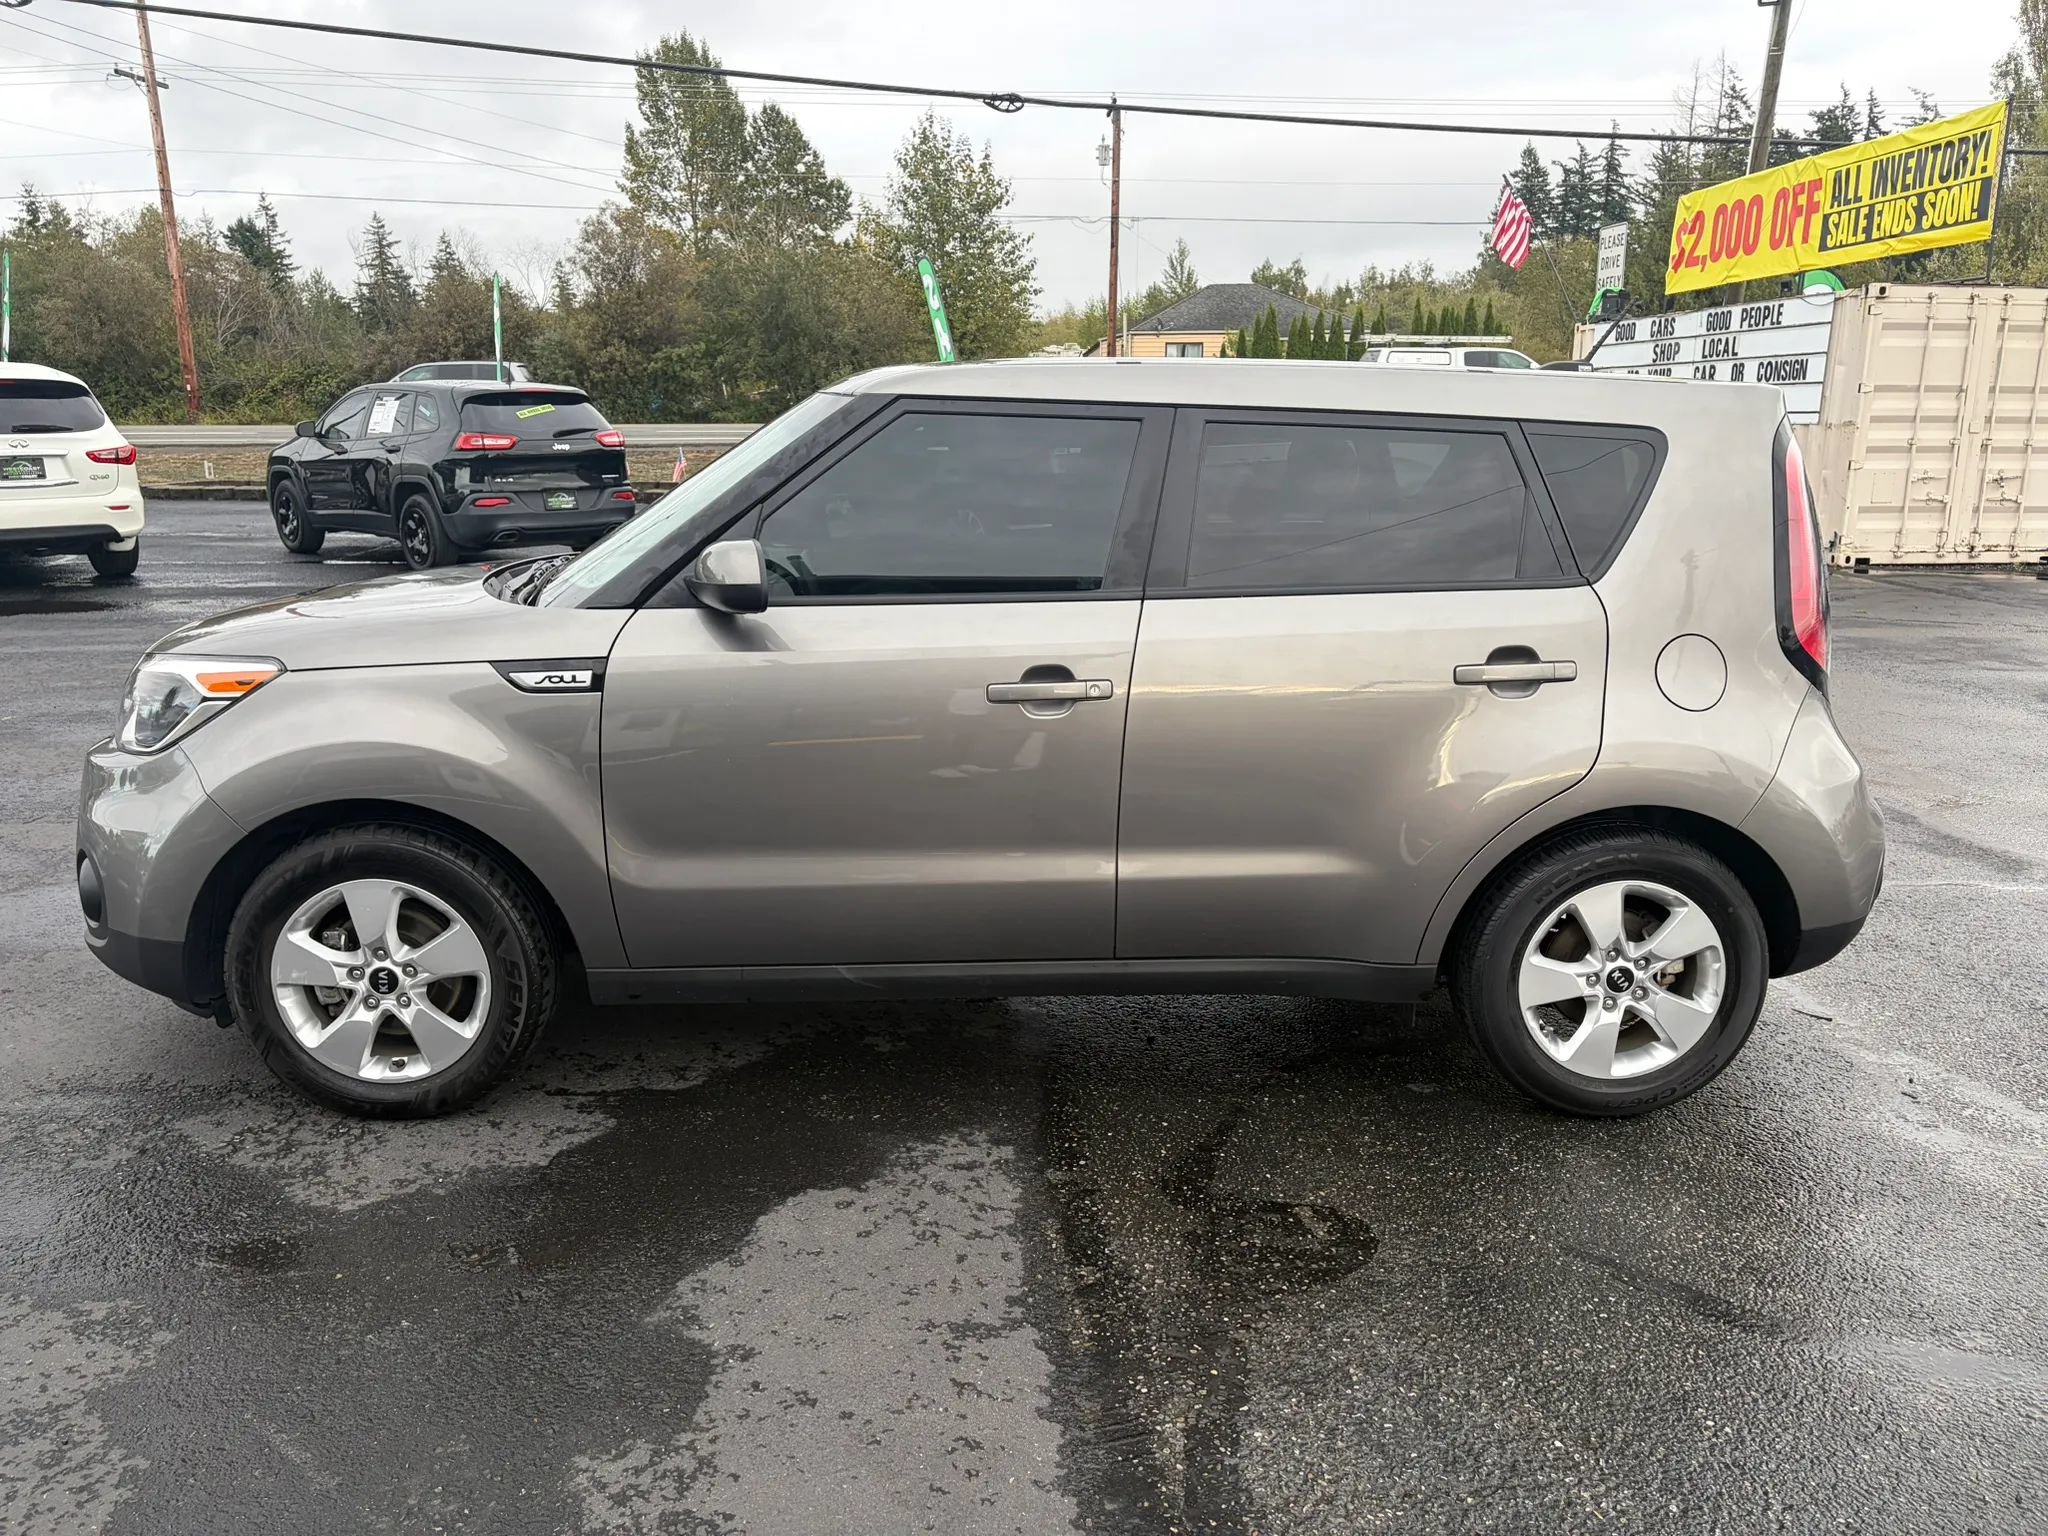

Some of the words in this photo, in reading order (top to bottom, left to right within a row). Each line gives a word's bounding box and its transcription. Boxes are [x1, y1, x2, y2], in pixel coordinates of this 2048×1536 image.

[1830, 164, 1863, 209] ALL
[1869, 129, 1993, 200] INVENTORY!
[1827, 204, 1869, 248] SALE
[1872, 195, 1918, 240] ENDS
[1922, 179, 1982, 230] SOON!
[1671, 194, 1764, 274] $2,000
[1769, 178, 1823, 251] OFF
[1600, 233, 1625, 250] PLEASE
[1601, 254, 1621, 270] DRIVE
[1615, 322, 1636, 341] GOOD
[1650, 318, 1676, 339] CARS
[1706, 310, 1732, 332] GOOD
[1740, 303, 1784, 328] PEOPLE
[1652, 342, 1681, 363] SHOP
[1702, 336, 1738, 359] LOCAL
[1693, 364, 1716, 381] CAR
[1730, 362, 1745, 382] OR
[1756, 358, 1809, 383] CONSIGN
[552, 443, 570, 451] Jeep
[534, 675, 586, 685] SOUL
[378, 970, 389, 992] KIA
[1611, 969, 1629, 991] KIA
